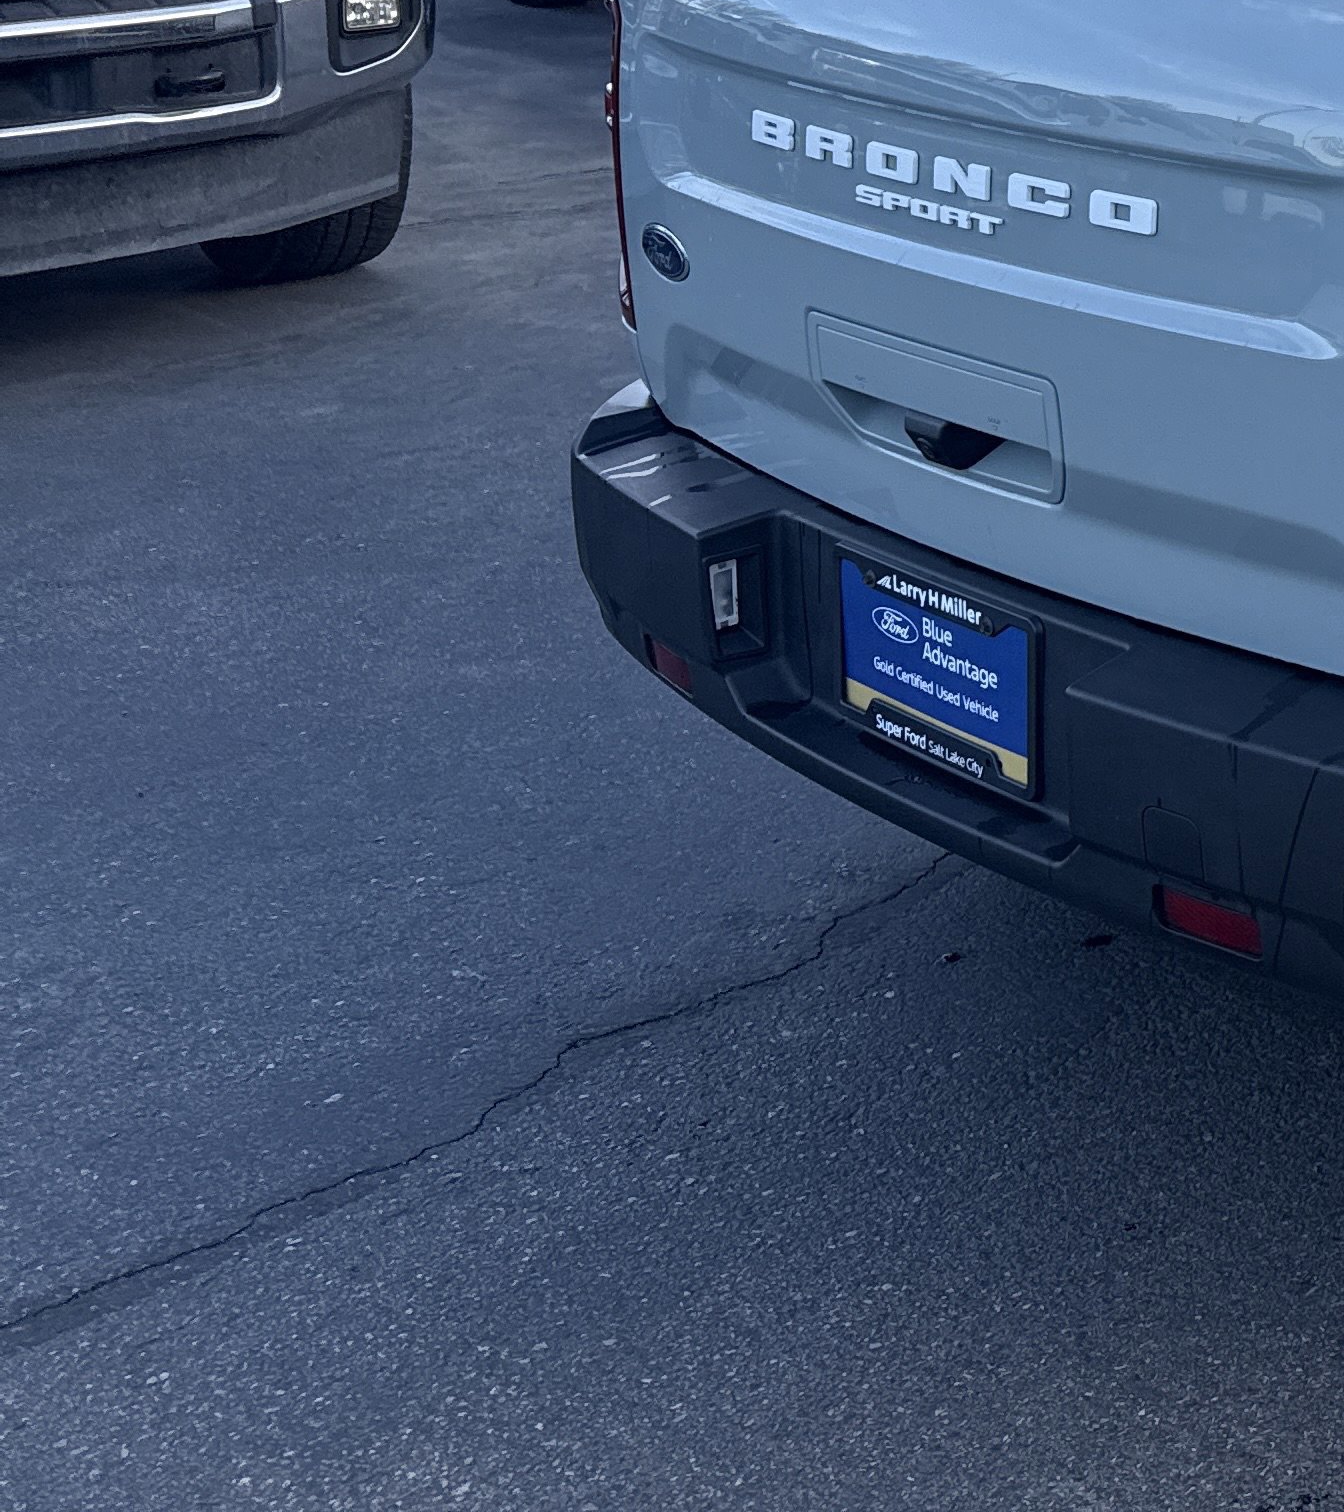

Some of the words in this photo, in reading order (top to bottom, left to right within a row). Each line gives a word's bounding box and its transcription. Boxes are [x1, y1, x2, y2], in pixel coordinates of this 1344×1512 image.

[751, 108, 1159, 238] BRONCO
[854, 182, 1006, 236] SPORT
[880, 610, 911, 642] Ford
[892, 574, 928, 607] Larry
[928, 589, 939, 608] H
[940, 594, 983, 627] Miller
[922, 617, 954, 648] Blue
[873, 656, 895, 678] Gold
[895, 666, 935, 697] Certified
[936, 683, 961, 707] Used
[962, 694, 1000, 723] Vehicle
[922, 642, 998, 690] Advantage
[875, 713, 904, 741] Super
[904, 726, 927, 750] Ford
[928, 740, 945, 759] Salt
[945, 747, 966, 768] Lake
[966, 757, 985, 779] City
